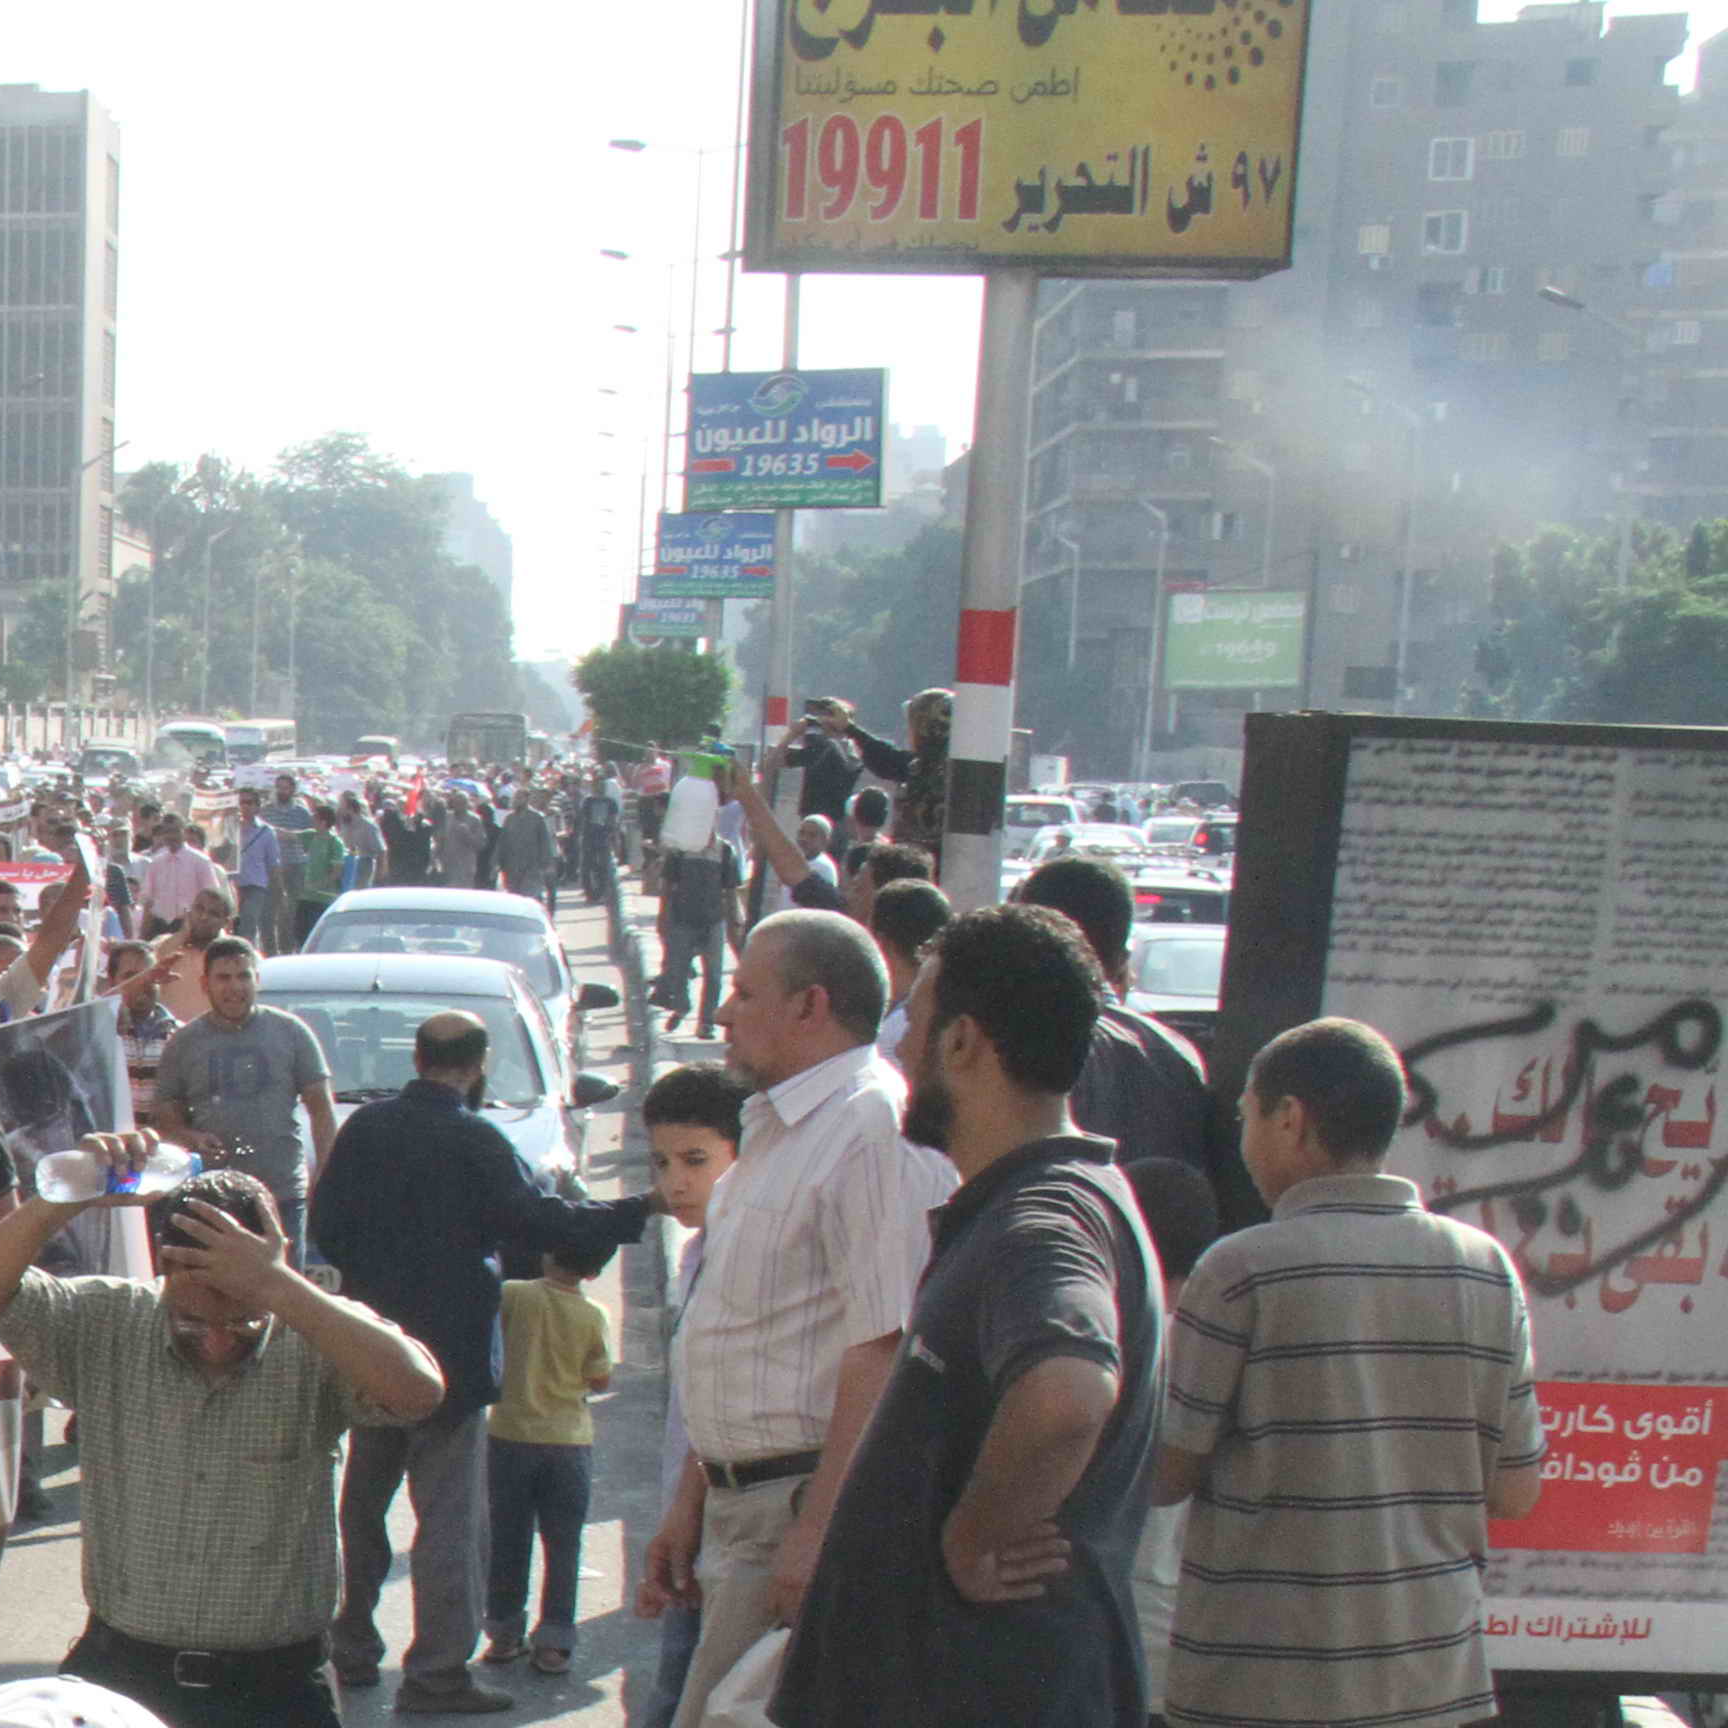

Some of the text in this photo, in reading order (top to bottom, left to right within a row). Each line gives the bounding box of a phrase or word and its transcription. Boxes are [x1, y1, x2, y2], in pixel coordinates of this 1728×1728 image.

[782, 115, 984, 222] 19911
[1001, 145, 1150, 233] التحرير
[1166, 143, 1214, 233] ش
[792, 416, 874, 450] الرواد
[740, 452, 820, 477] 19635
[1622, 1398, 1713, 1440] أقوى
[1649, 1454, 1704, 1491] من
